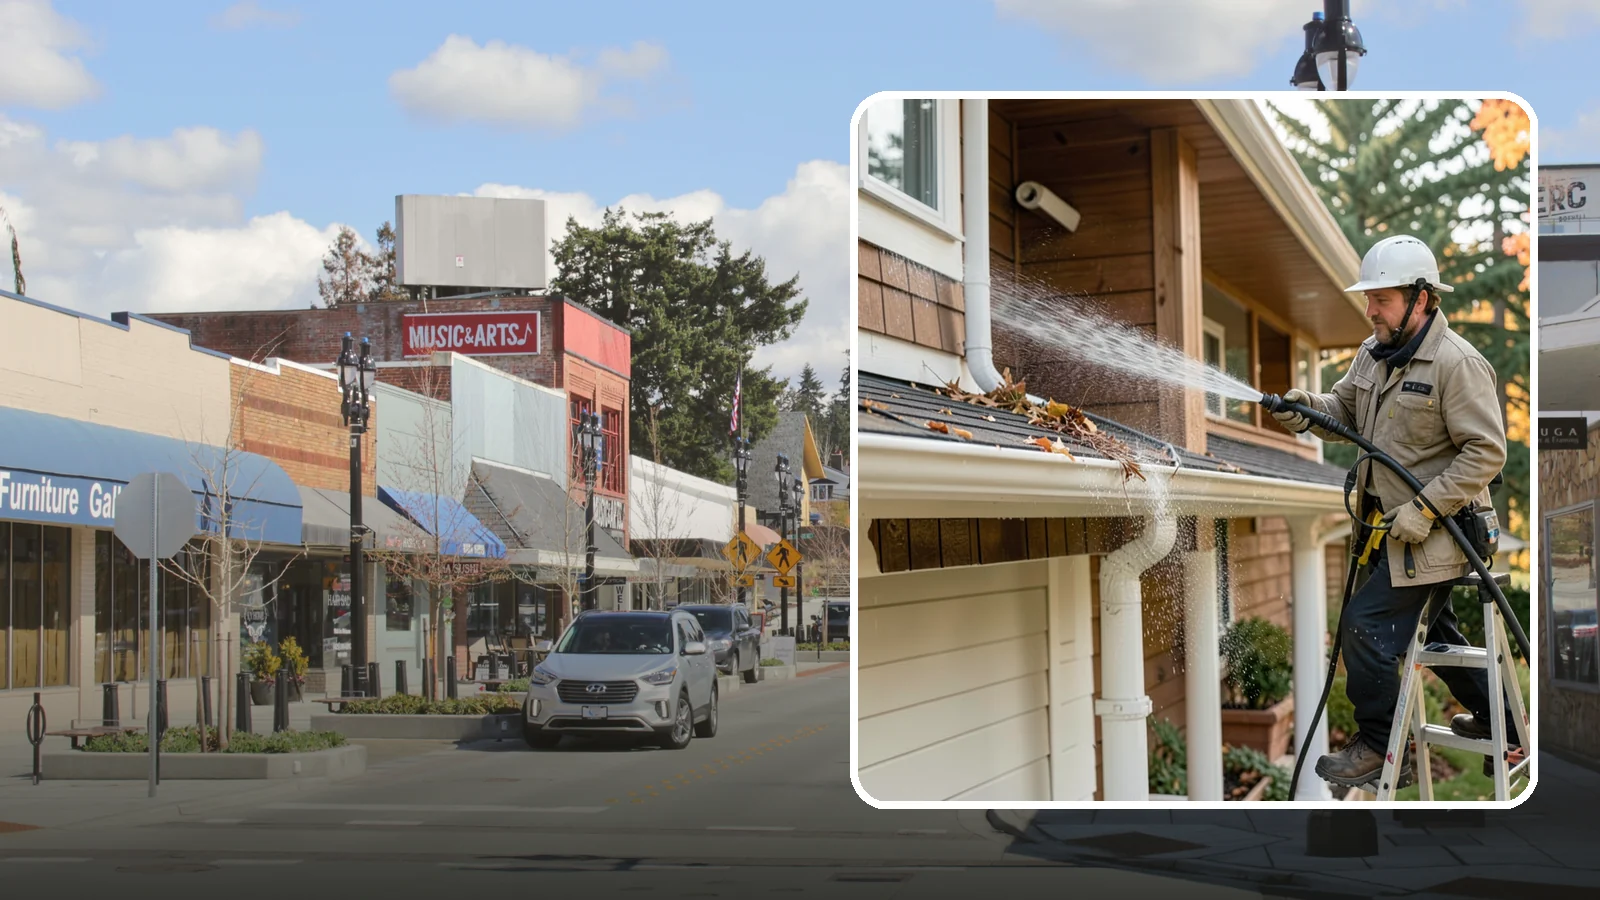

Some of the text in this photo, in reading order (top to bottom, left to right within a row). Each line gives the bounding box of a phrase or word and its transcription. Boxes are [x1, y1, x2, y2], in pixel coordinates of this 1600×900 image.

[1538, 181, 1587, 213] ERC
[408, 322, 520, 349] MUSIC&ARTS
[1540, 428, 1577, 437] UGA
[0, 471, 122, 519] Furniture Gal
[453, 563, 479, 574] SUSHI
